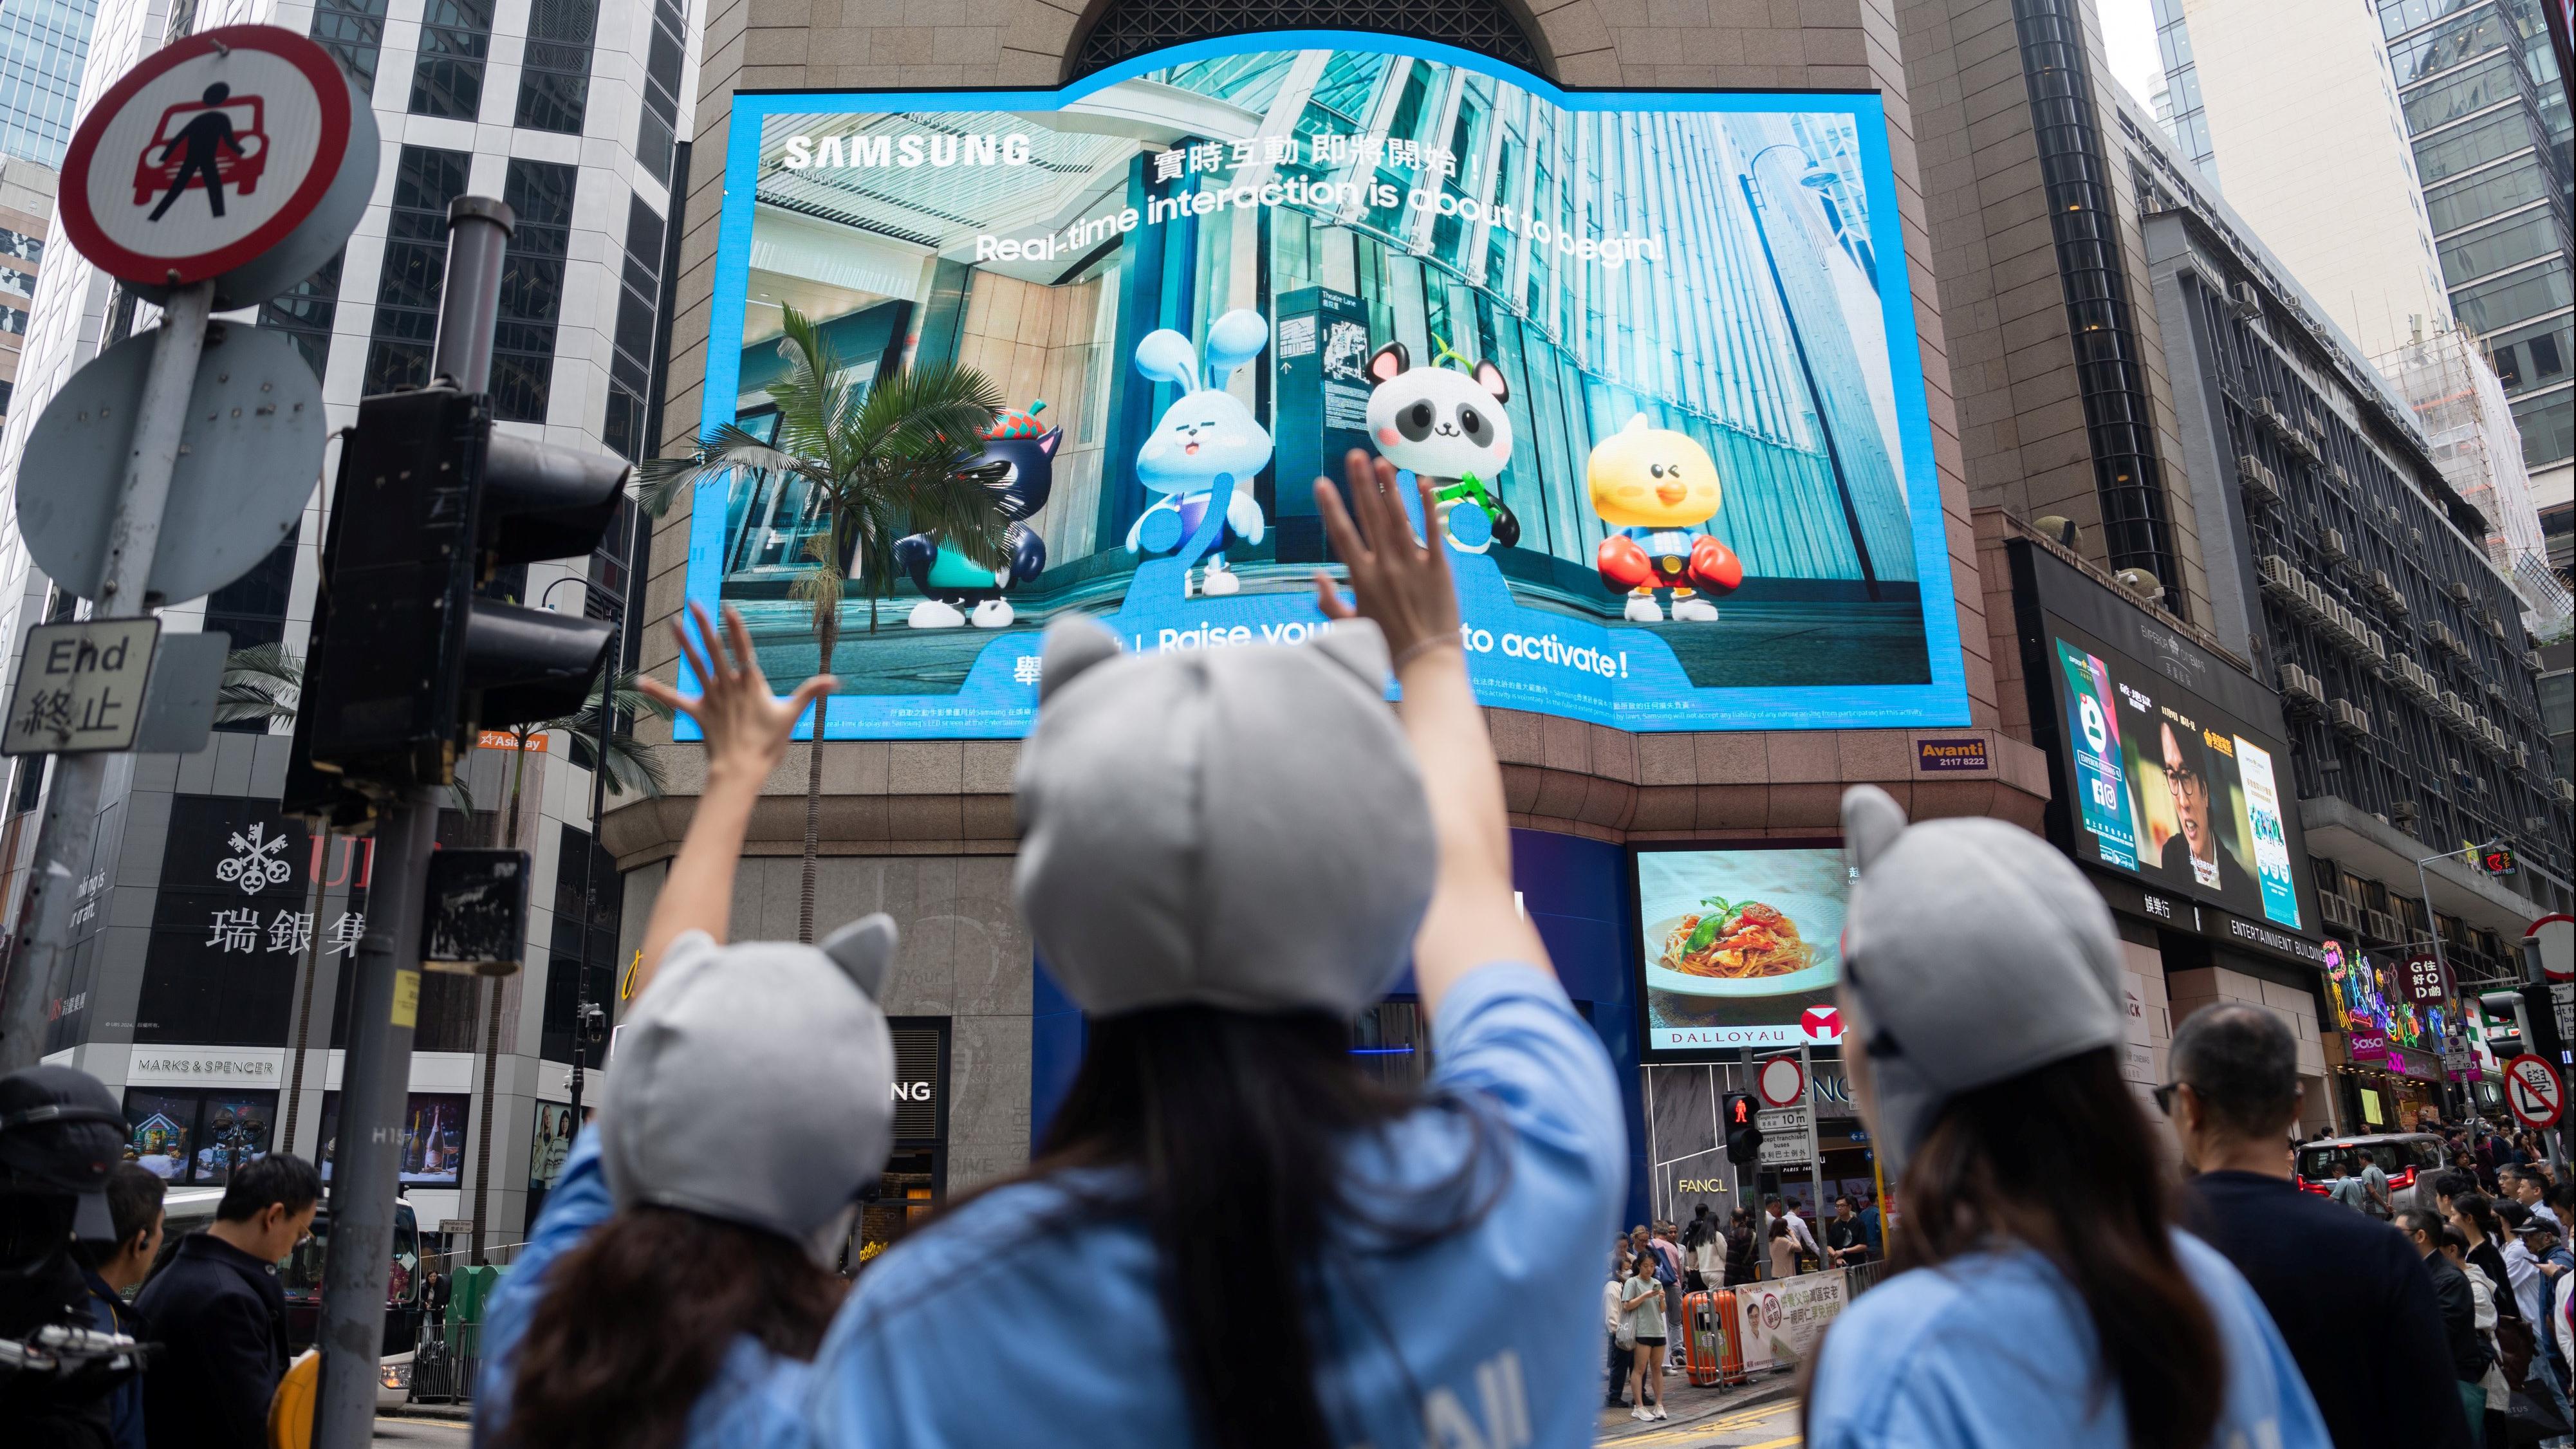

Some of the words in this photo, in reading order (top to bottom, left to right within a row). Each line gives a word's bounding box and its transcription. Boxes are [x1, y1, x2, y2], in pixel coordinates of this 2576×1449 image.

[784, 133, 1031, 170] SAMSUNG
[1153, 133, 1299, 185] 實時互動
[976, 203, 1138, 263] Real-time
[1147, 172, 1359, 225] interaction
[1371, 176, 1399, 209] is
[1408, 180, 1515, 231] about
[1521, 207, 1552, 245] to
[1557, 220, 1665, 269] begin!
[1344, 297, 1357, 308] Lane
[45, 636, 129, 674] End
[1159, 621, 1252, 654] Raise
[1459, 622, 1494, 653] to
[1501, 634, 1629, 679] activate!
[17, 686, 122, 737] 終止
[495, 735, 540, 751] Asiaay
[1922, 742, 1983, 757] Avanti
[98, 867, 106, 889] is
[2144, 894, 2170, 919] 娛樂行
[2231, 919, 2292, 952] ENTERTAINMENT
[2294, 941, 2327, 963] BUILDING
[1672, 1031, 1784, 1043] DALLOYAU
[2352, 1037, 2384, 1050] sasa
[138, 1060, 189, 1072] MARKS
[192, 1060, 201, 1071] &
[205, 1061, 273, 1073] SPENCER
[1782, 1114, 1794, 1125] 10
[1797, 1115, 1805, 1123] m
[1777, 1134, 1806, 1142] franchised
[1679, 1179, 1728, 1193] FANCL
